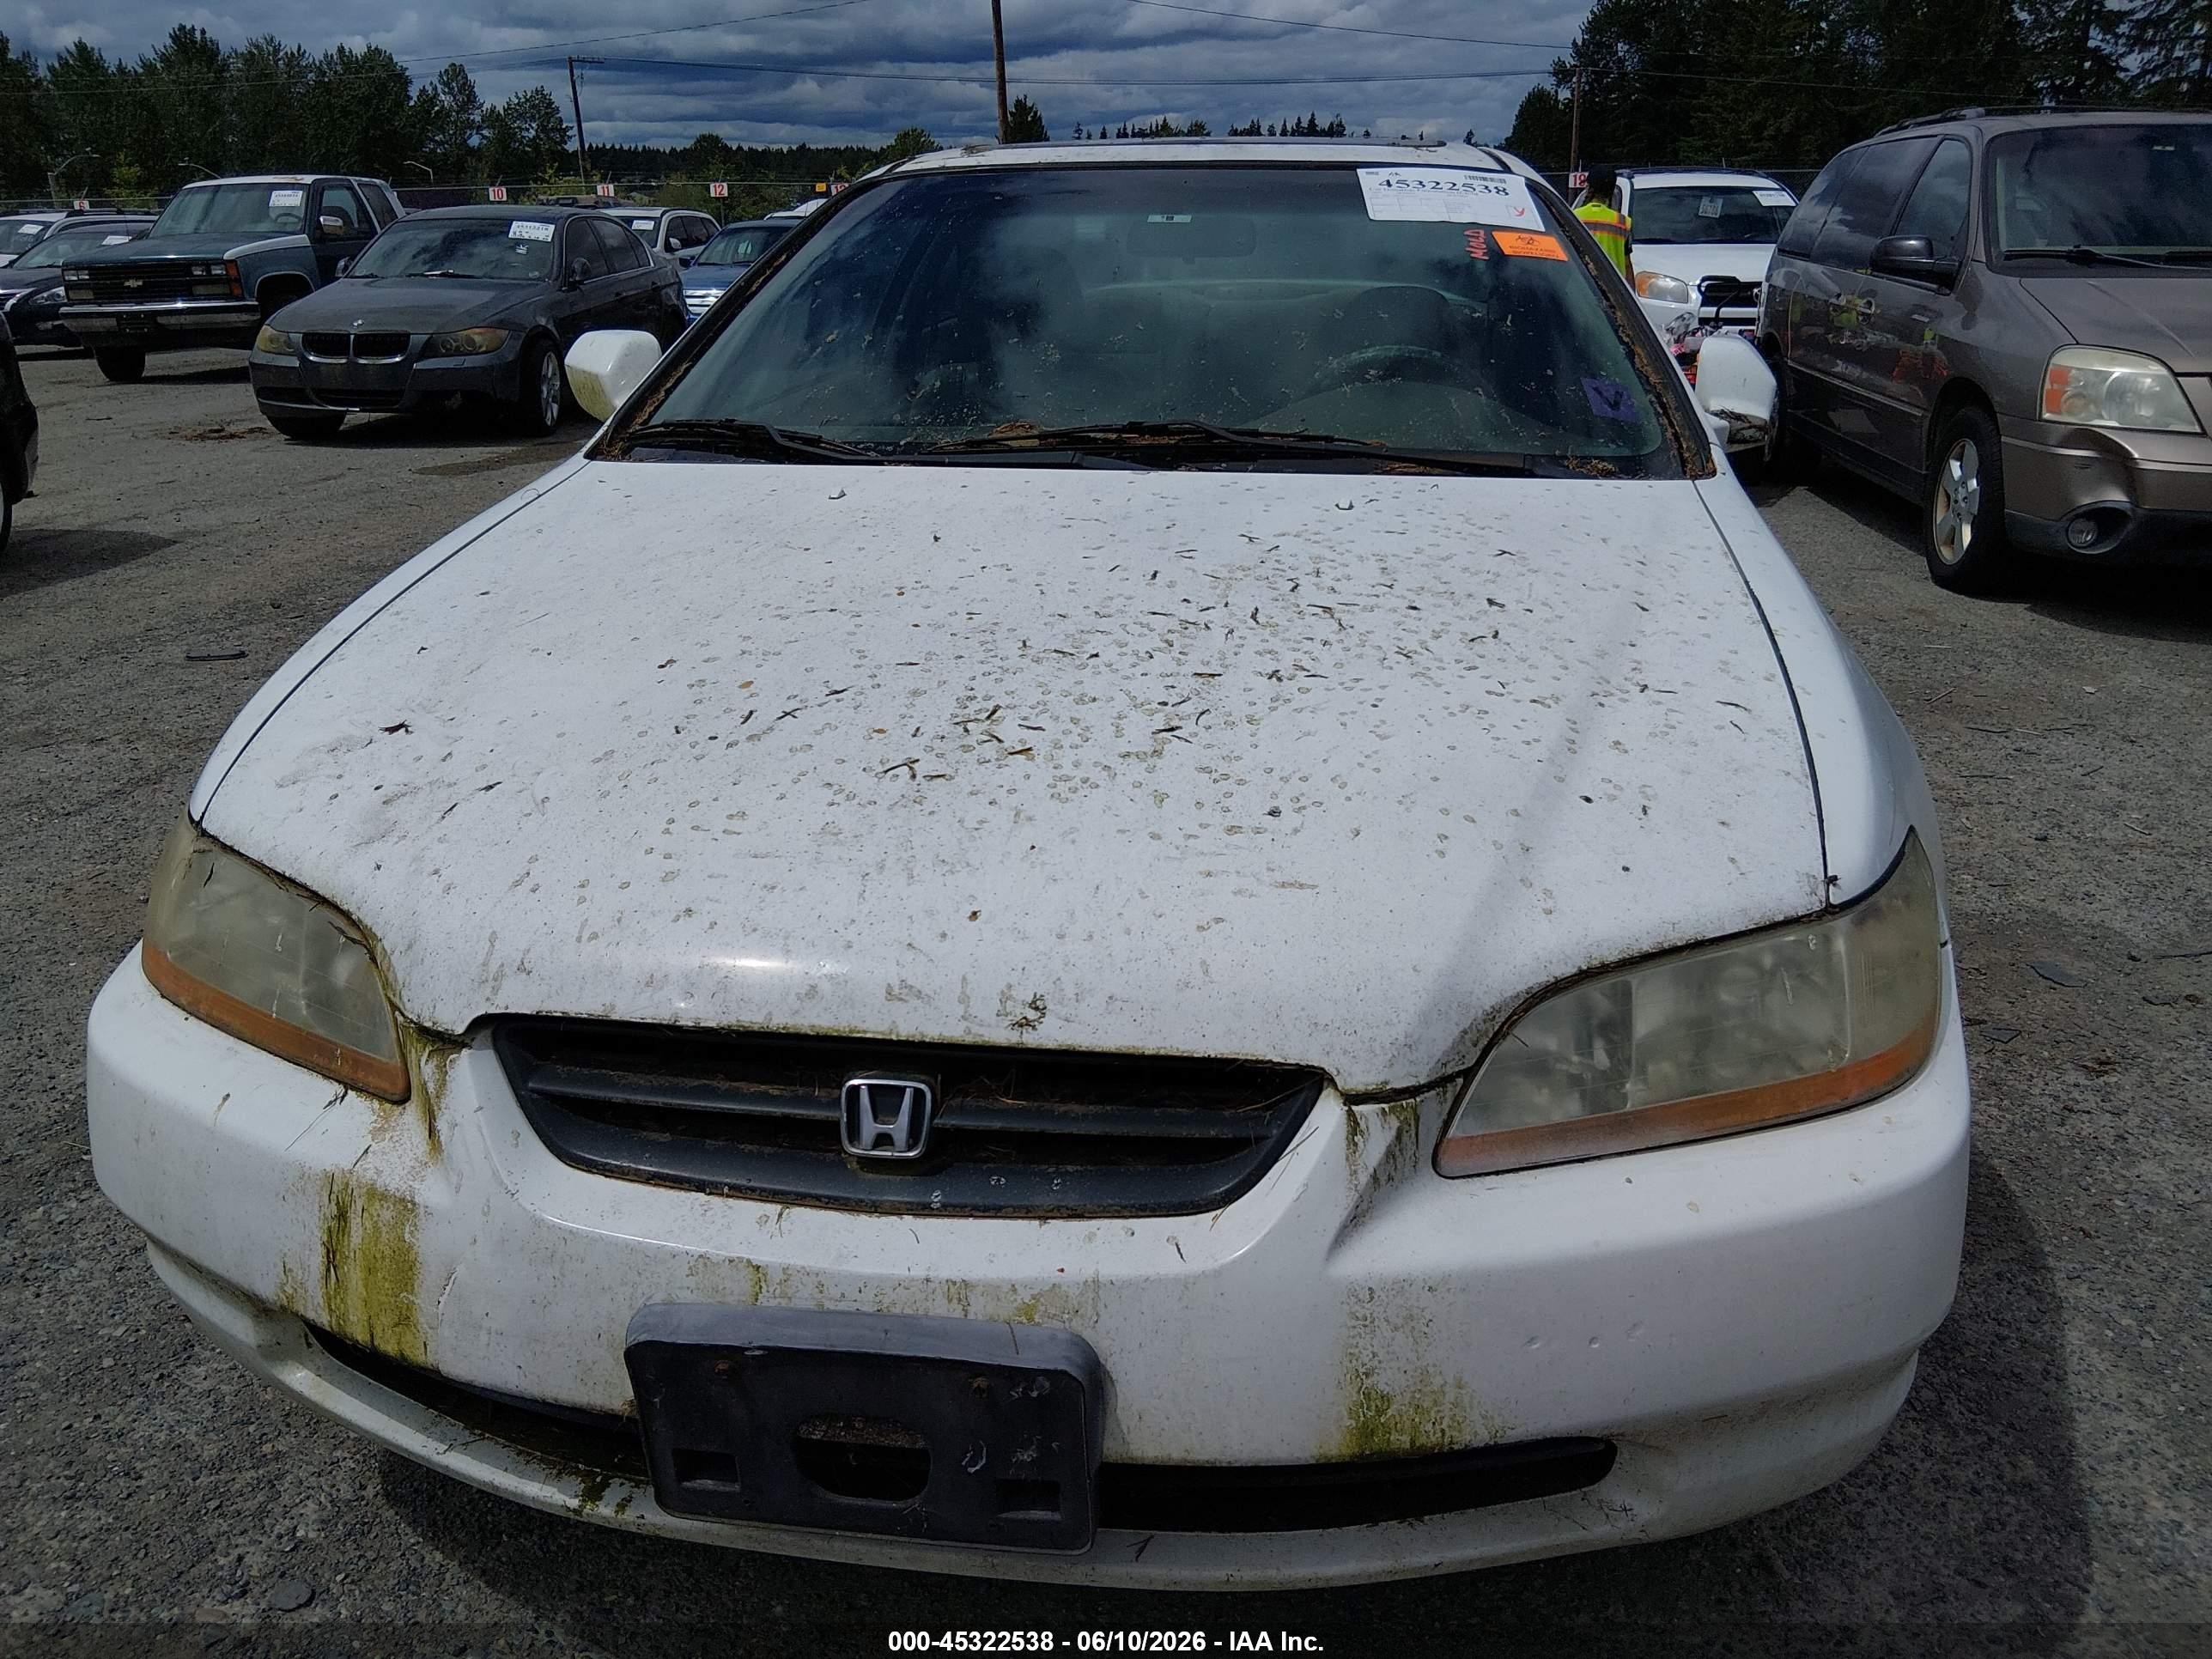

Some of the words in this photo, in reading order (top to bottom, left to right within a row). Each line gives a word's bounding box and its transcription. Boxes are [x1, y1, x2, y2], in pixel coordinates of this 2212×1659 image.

[491, 188, 504, 200] 10
[601, 185, 611, 197] 11
[713, 182, 725, 196] 12
[1378, 179, 1510, 197] 45322538
[1463, 228, 1490, 260] MOLD
